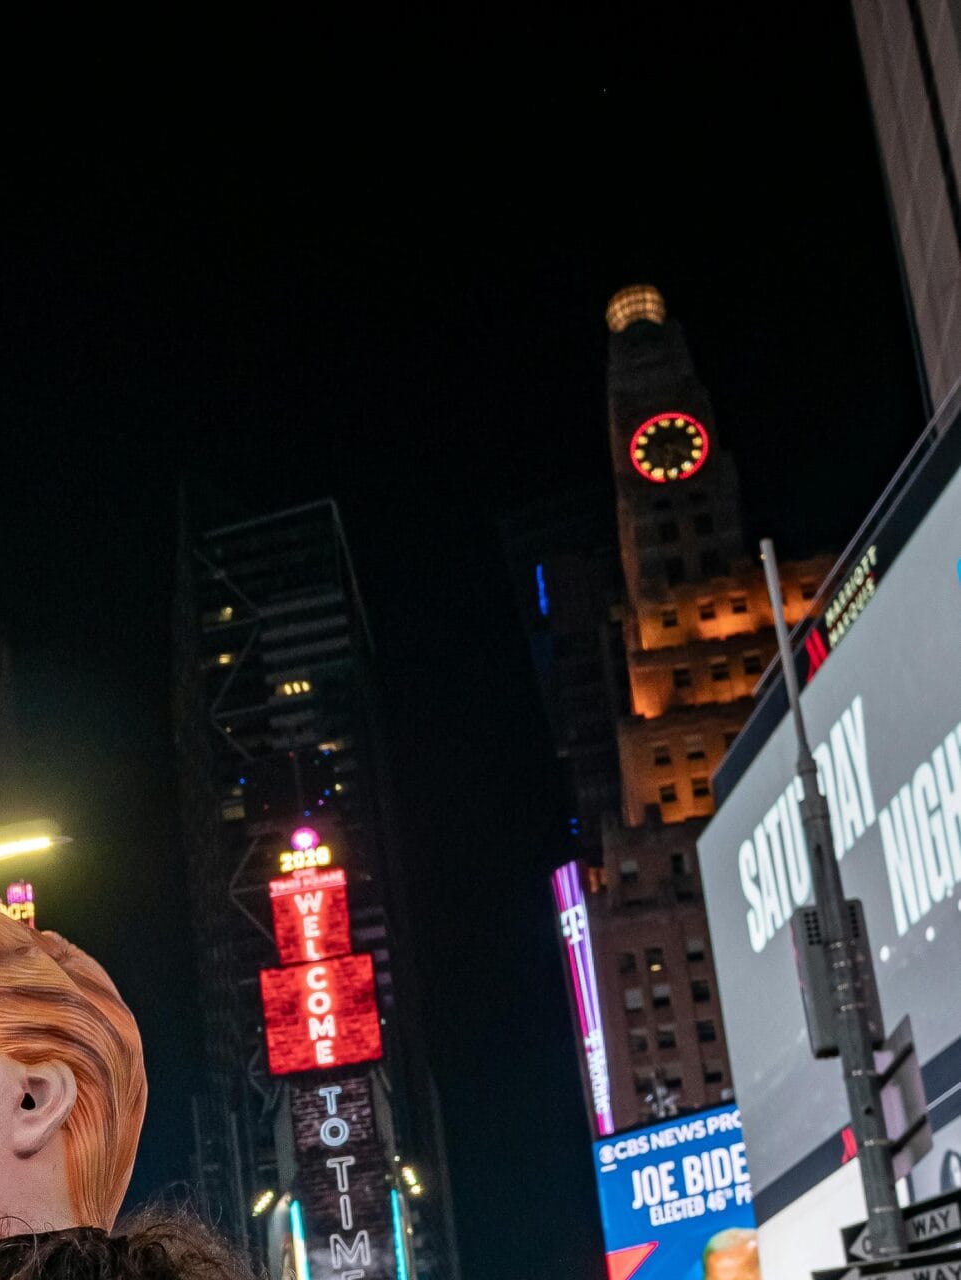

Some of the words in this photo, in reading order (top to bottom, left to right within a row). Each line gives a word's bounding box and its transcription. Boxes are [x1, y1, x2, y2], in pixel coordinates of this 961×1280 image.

[739, 693, 876, 953] SATUDAY
[878, 720, 961, 937] NIGH
[293, 889, 337, 1066] WELCOME
[318, 1086, 351, 1147] TO
[615, 1135, 651, 1160] CBS
[650, 1119, 707, 1151] NEWS
[631, 1160, 680, 1210] JOE
[682, 1141, 752, 1197] BIDE
[649, 1195, 706, 1228] ELECTED
[911, 1210, 950, 1238] WAY
